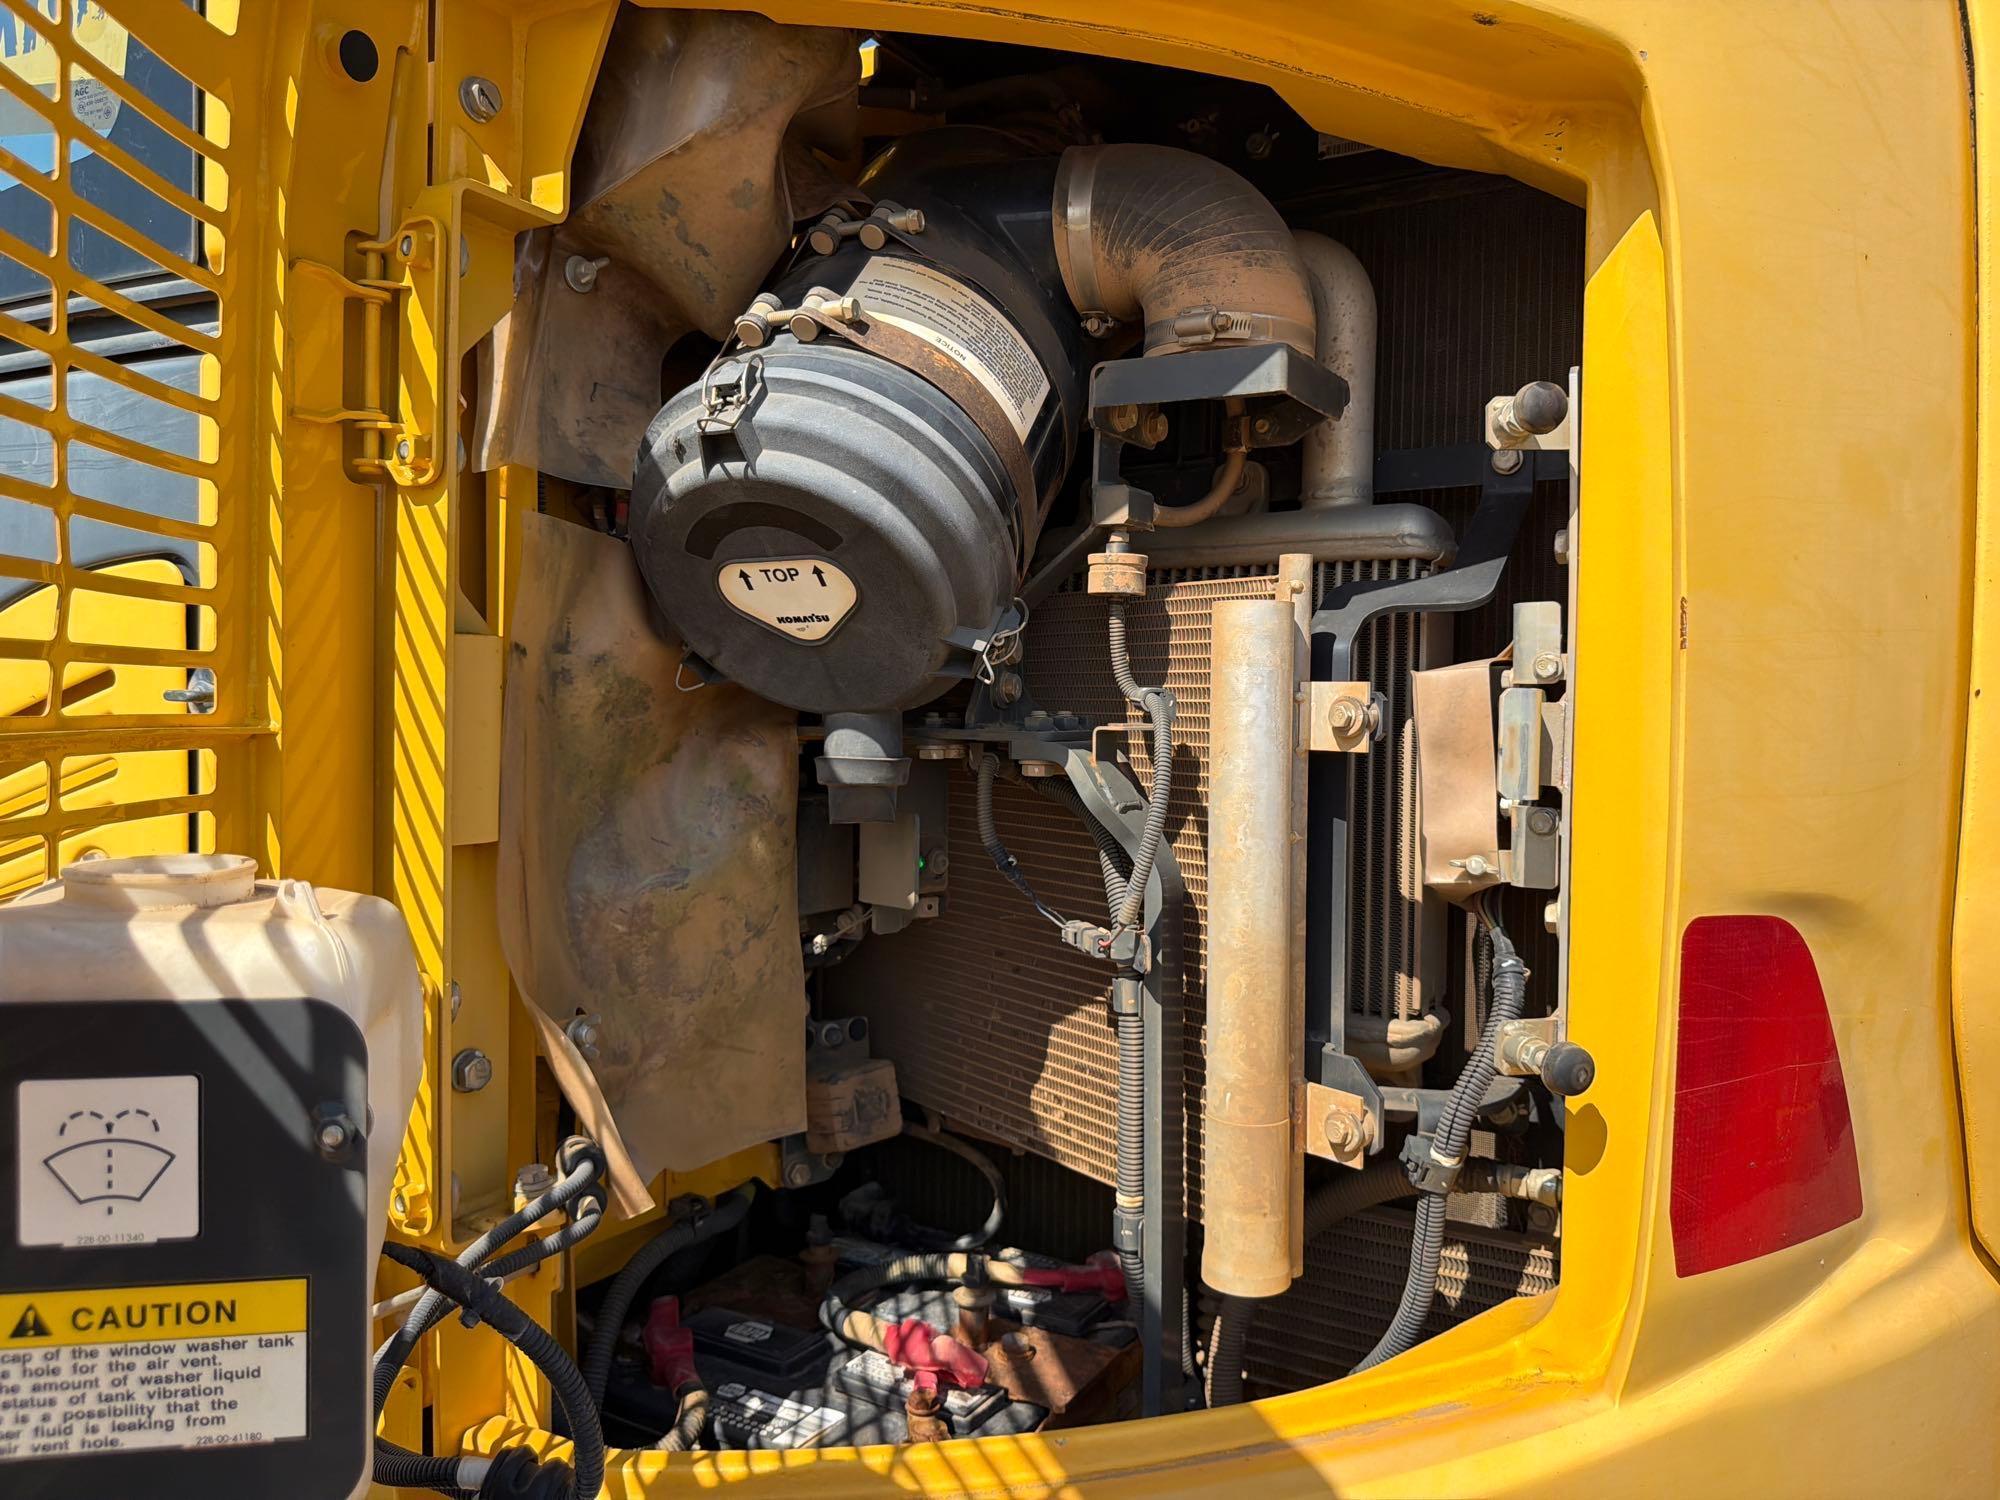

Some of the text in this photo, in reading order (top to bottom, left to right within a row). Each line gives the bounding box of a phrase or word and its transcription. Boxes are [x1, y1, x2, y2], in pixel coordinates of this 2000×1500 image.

[936, 336, 966, 361] NOTICE
[759, 568, 799, 582] TOP
[776, 614, 830, 624] KOMATSU
[71, 1299, 237, 1331] CAUTION
[1, 1335, 294, 1367] cap of the window washer tank
[22, 1364, 61, 1378] hole
[72, 1362, 97, 1375] for
[108, 1360, 136, 1372] the
[147, 1356, 169, 1370] air
[181, 1354, 222, 1368] vent.
[32, 1379, 100, 1392] amount
[111, 1374, 128, 1388] of
[139, 1370, 202, 1386] washer
[213, 1366, 261, 1382] liquid
[2, 1385, 224, 1410] status of tank vibration
[63, 1402, 155, 1423] possibility
[167, 1400, 200, 1414] that
[211, 1397, 239, 1411] the
[34, 1424, 73, 1438] fluid
[111, 1417, 175, 1433] leaking
[186, 1413, 226, 1428] from
[31, 1439, 70, 1452] vent
[81, 1435, 124, 1449] hole.
